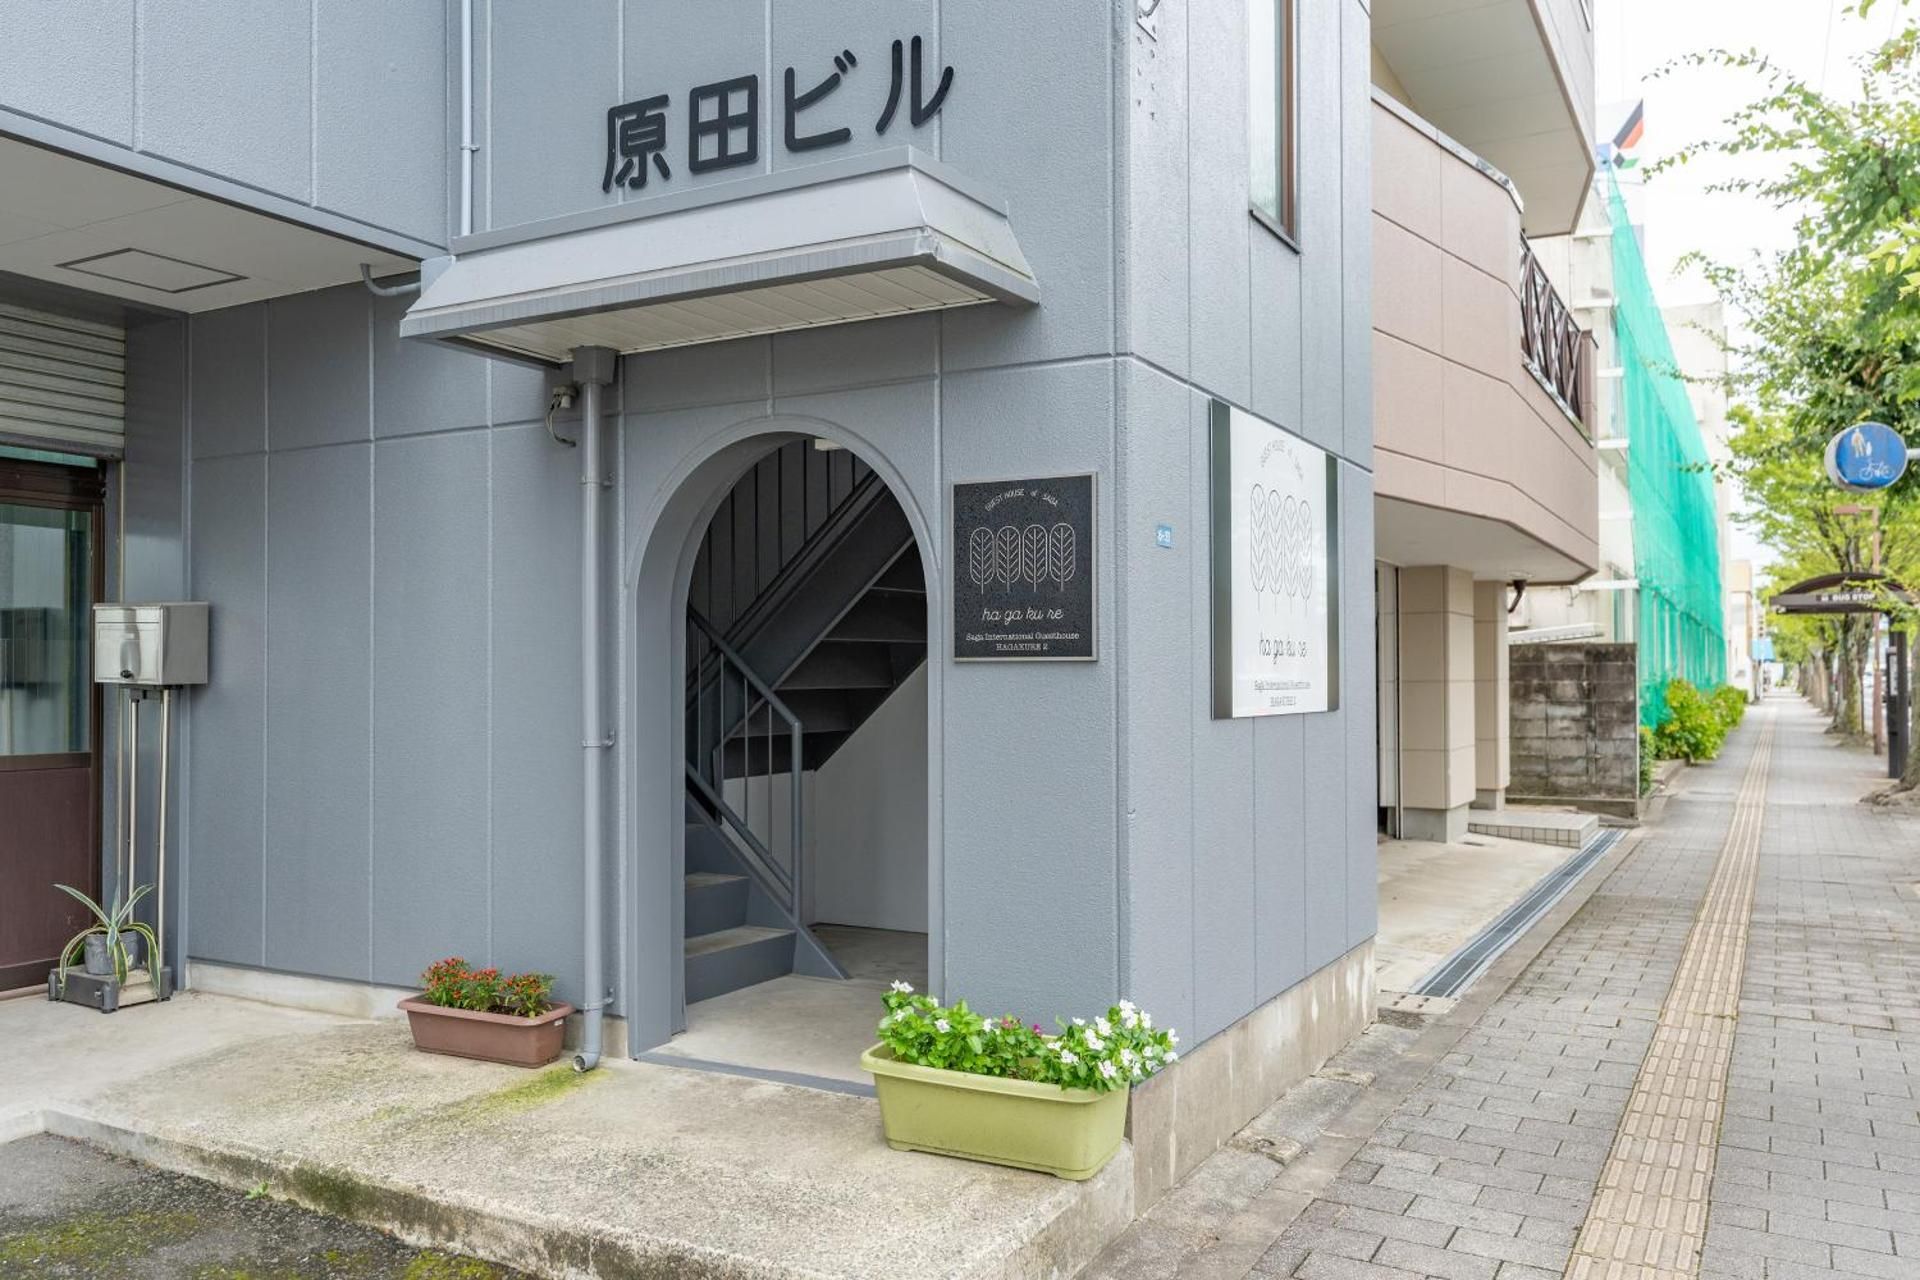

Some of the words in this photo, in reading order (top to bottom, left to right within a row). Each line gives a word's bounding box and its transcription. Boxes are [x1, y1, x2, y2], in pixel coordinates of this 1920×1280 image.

[602, 35, 955, 193] 原田ビル
[982, 607, 1001, 620] ha
[1004, 609, 1023, 625] ga
[1047, 607, 1064, 619] re
[965, 633, 984, 642] Saga
[985, 632, 1034, 641] International
[1035, 631, 1080, 640] Guesthouse
[996, 643, 1041, 651] HAGAKURE
[1042, 643, 1049, 651] 2
